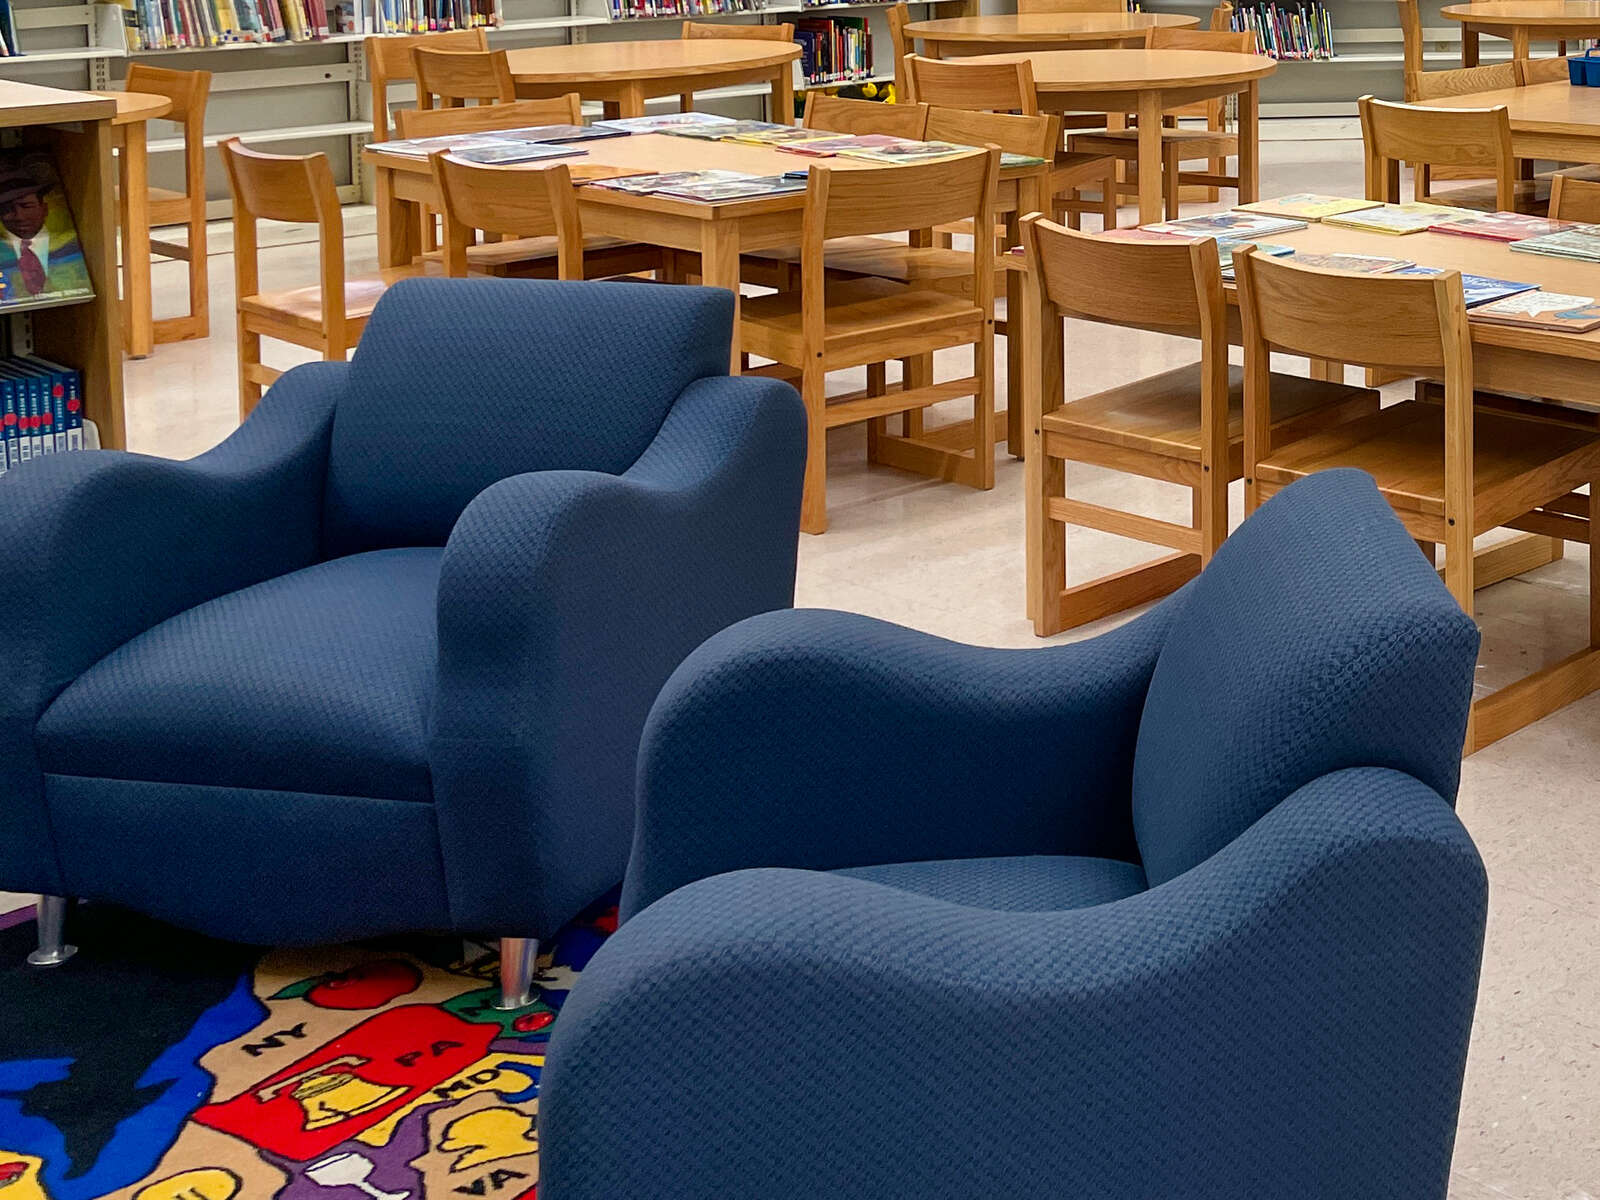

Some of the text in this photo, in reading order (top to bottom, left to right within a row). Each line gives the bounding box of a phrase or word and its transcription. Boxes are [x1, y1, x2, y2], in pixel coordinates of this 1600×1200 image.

[241, 1022, 307, 1057] NY
[394, 1040, 463, 1067] PA
[433, 1067, 500, 1099] MD
[450, 1168, 528, 1196] VA
